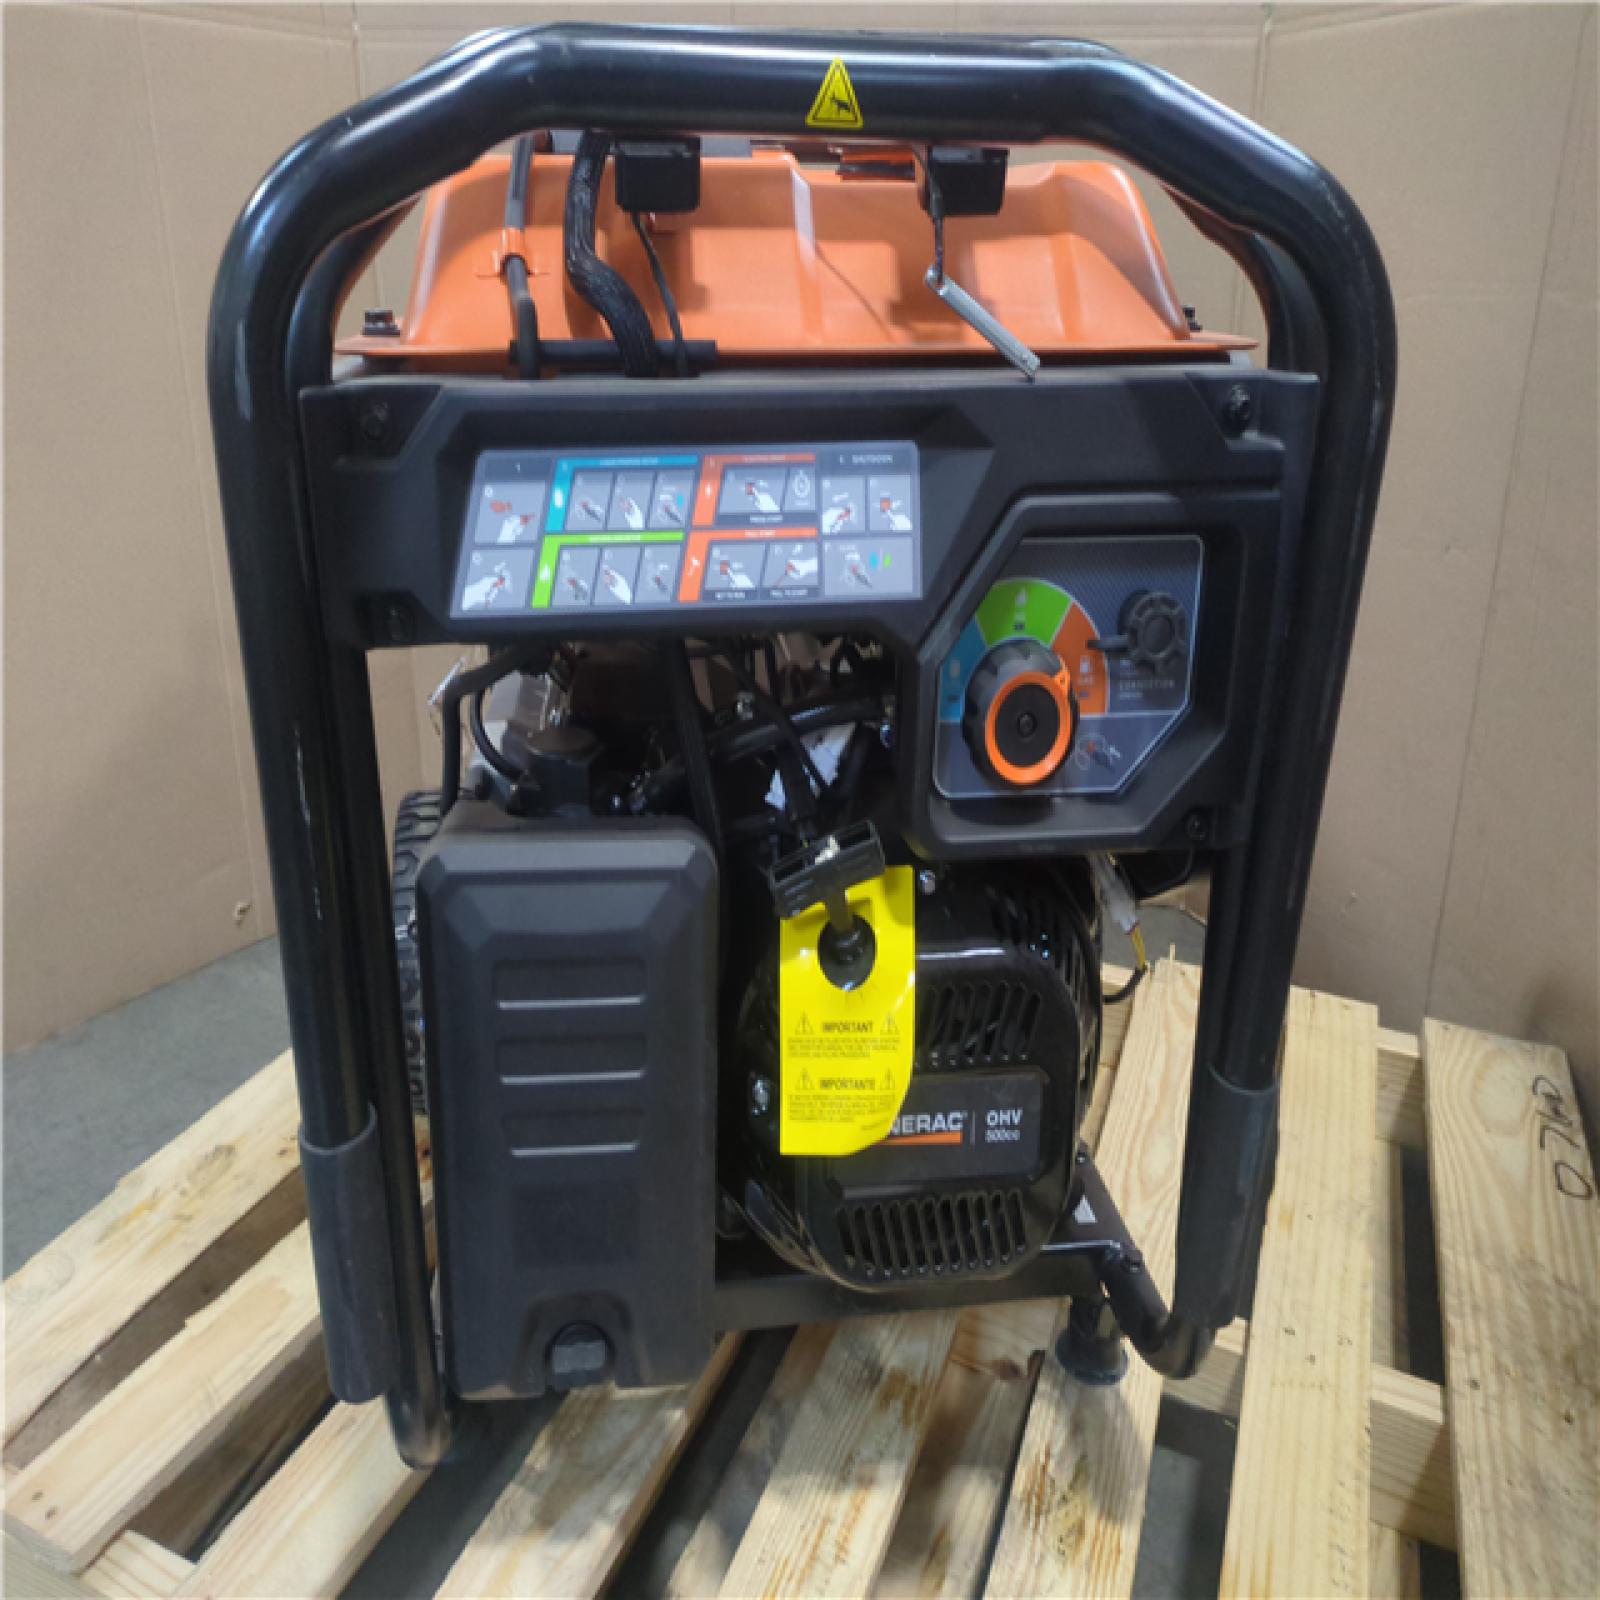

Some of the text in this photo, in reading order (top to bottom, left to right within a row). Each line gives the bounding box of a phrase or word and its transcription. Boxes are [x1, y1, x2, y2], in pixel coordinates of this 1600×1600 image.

[821, 1021, 874, 1033] IMPORTANT
[819, 1078, 876, 1091] IMPORTANTE
[986, 1108, 1023, 1126] OHV
